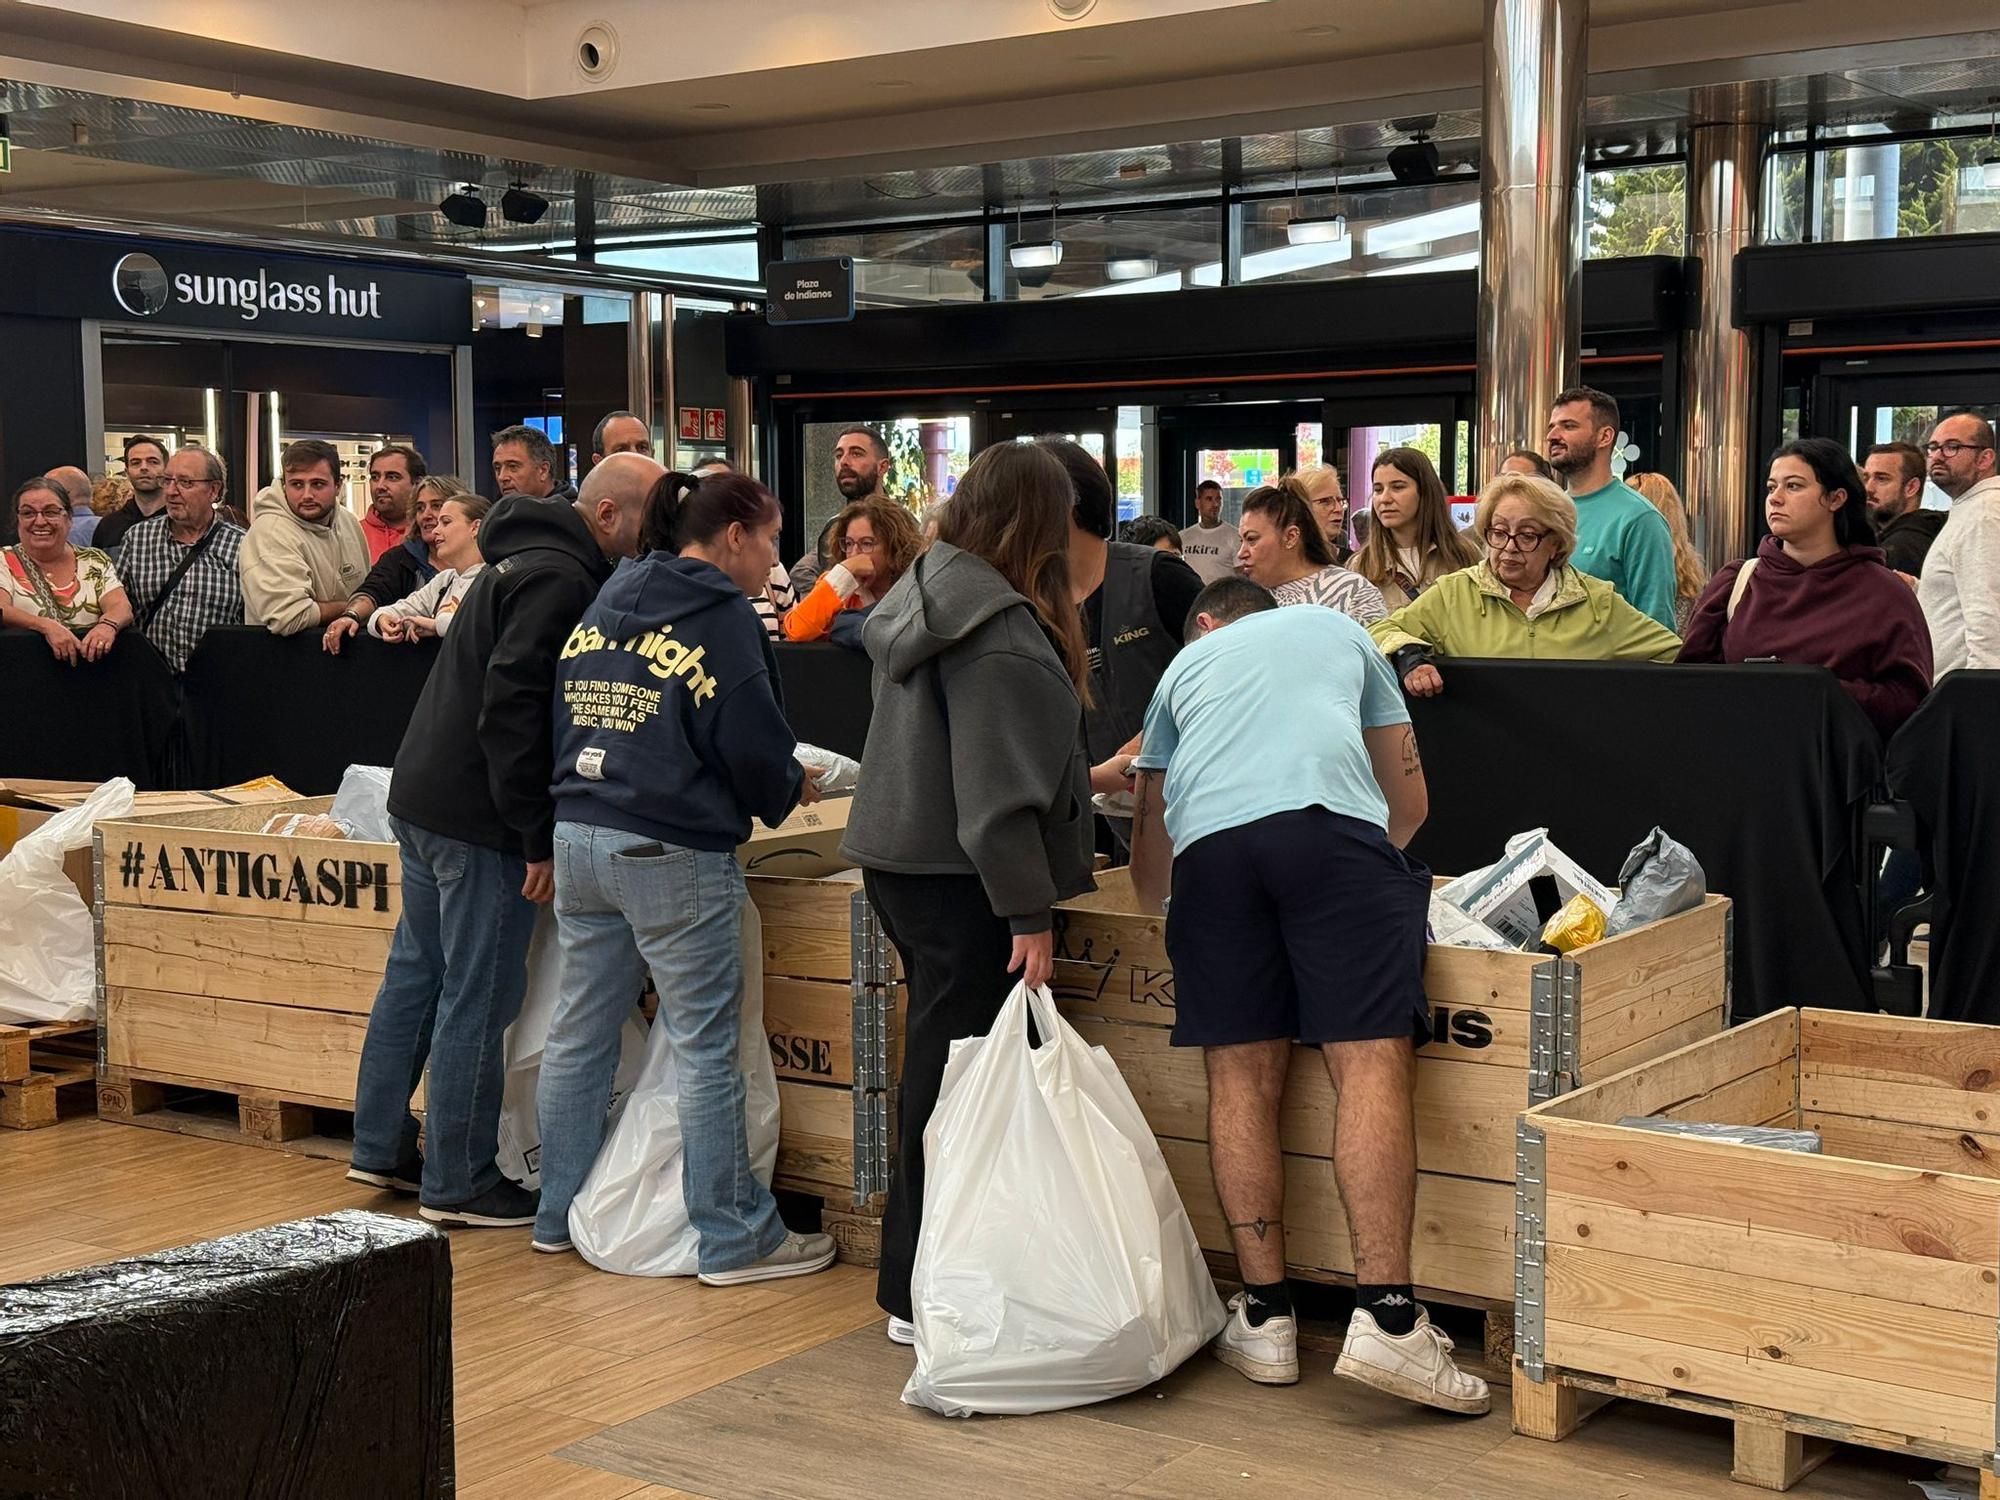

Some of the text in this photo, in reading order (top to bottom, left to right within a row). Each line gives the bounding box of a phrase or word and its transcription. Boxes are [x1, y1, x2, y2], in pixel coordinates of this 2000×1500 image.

[174, 268, 382, 320] sunglass hut
[796, 280, 819, 289] Plaza
[784, 290, 832, 300] de Indianos
[1184, 544, 1219, 555] akira
[1113, 627, 1150, 646] KING
[564, 681, 662, 702] IF YOU FIND SOMEONE
[564, 692, 580, 703] WHO
[612, 695, 628, 706] YOU
[629, 697, 659, 715] FEEL
[571, 703, 584, 714] THE
[584, 704, 611, 717] SAME
[627, 710, 647, 723] AS
[601, 717, 615, 730] YOU
[615, 720, 636, 733] WIN
[119, 841, 390, 913] #ANTIGASPI
